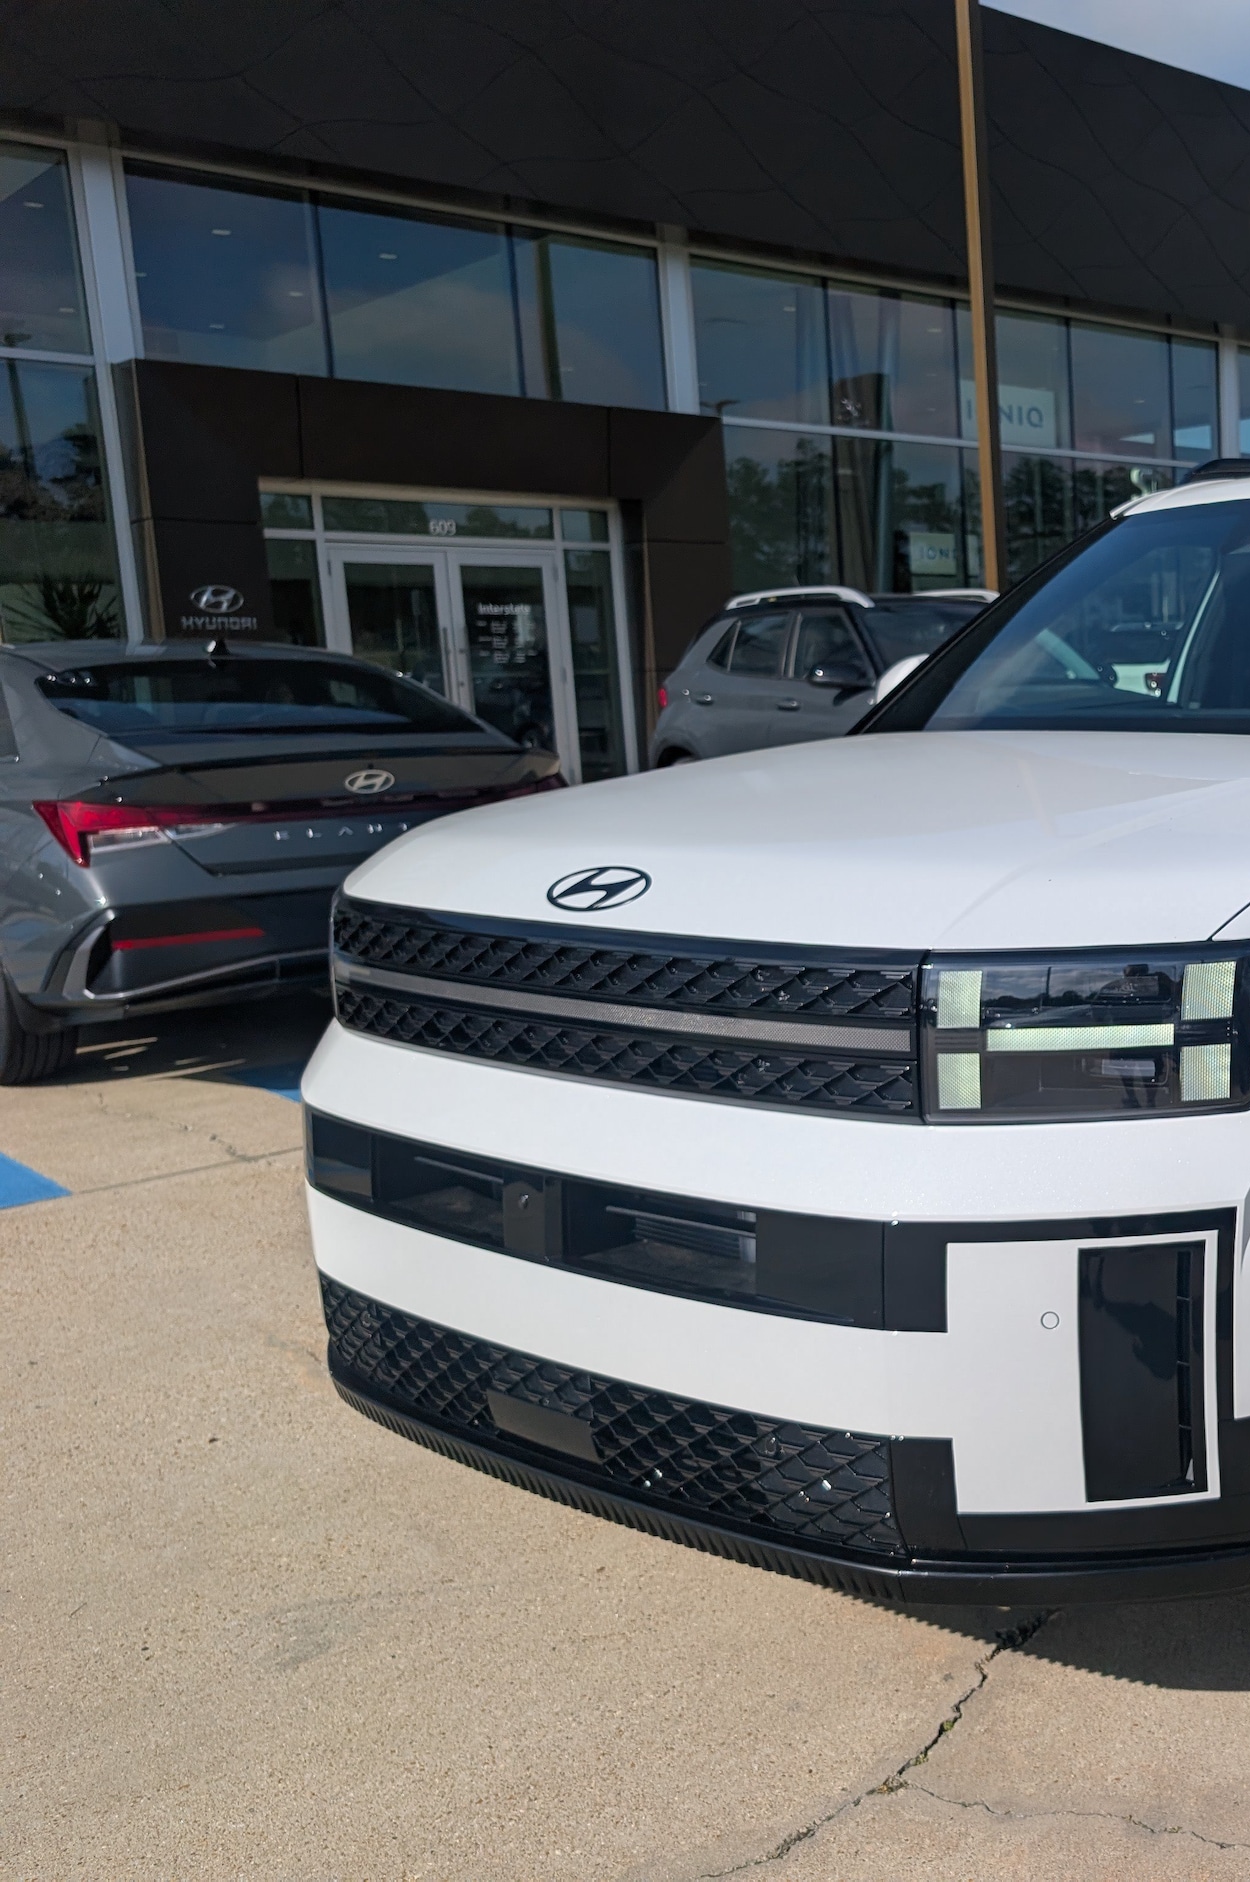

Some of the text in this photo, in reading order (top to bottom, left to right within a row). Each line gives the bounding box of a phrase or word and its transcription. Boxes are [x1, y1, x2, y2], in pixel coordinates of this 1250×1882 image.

[966, 399, 1044, 429] INIQ
[428, 518, 457, 536] 609
[181, 615, 257, 631] HYUNDAI
